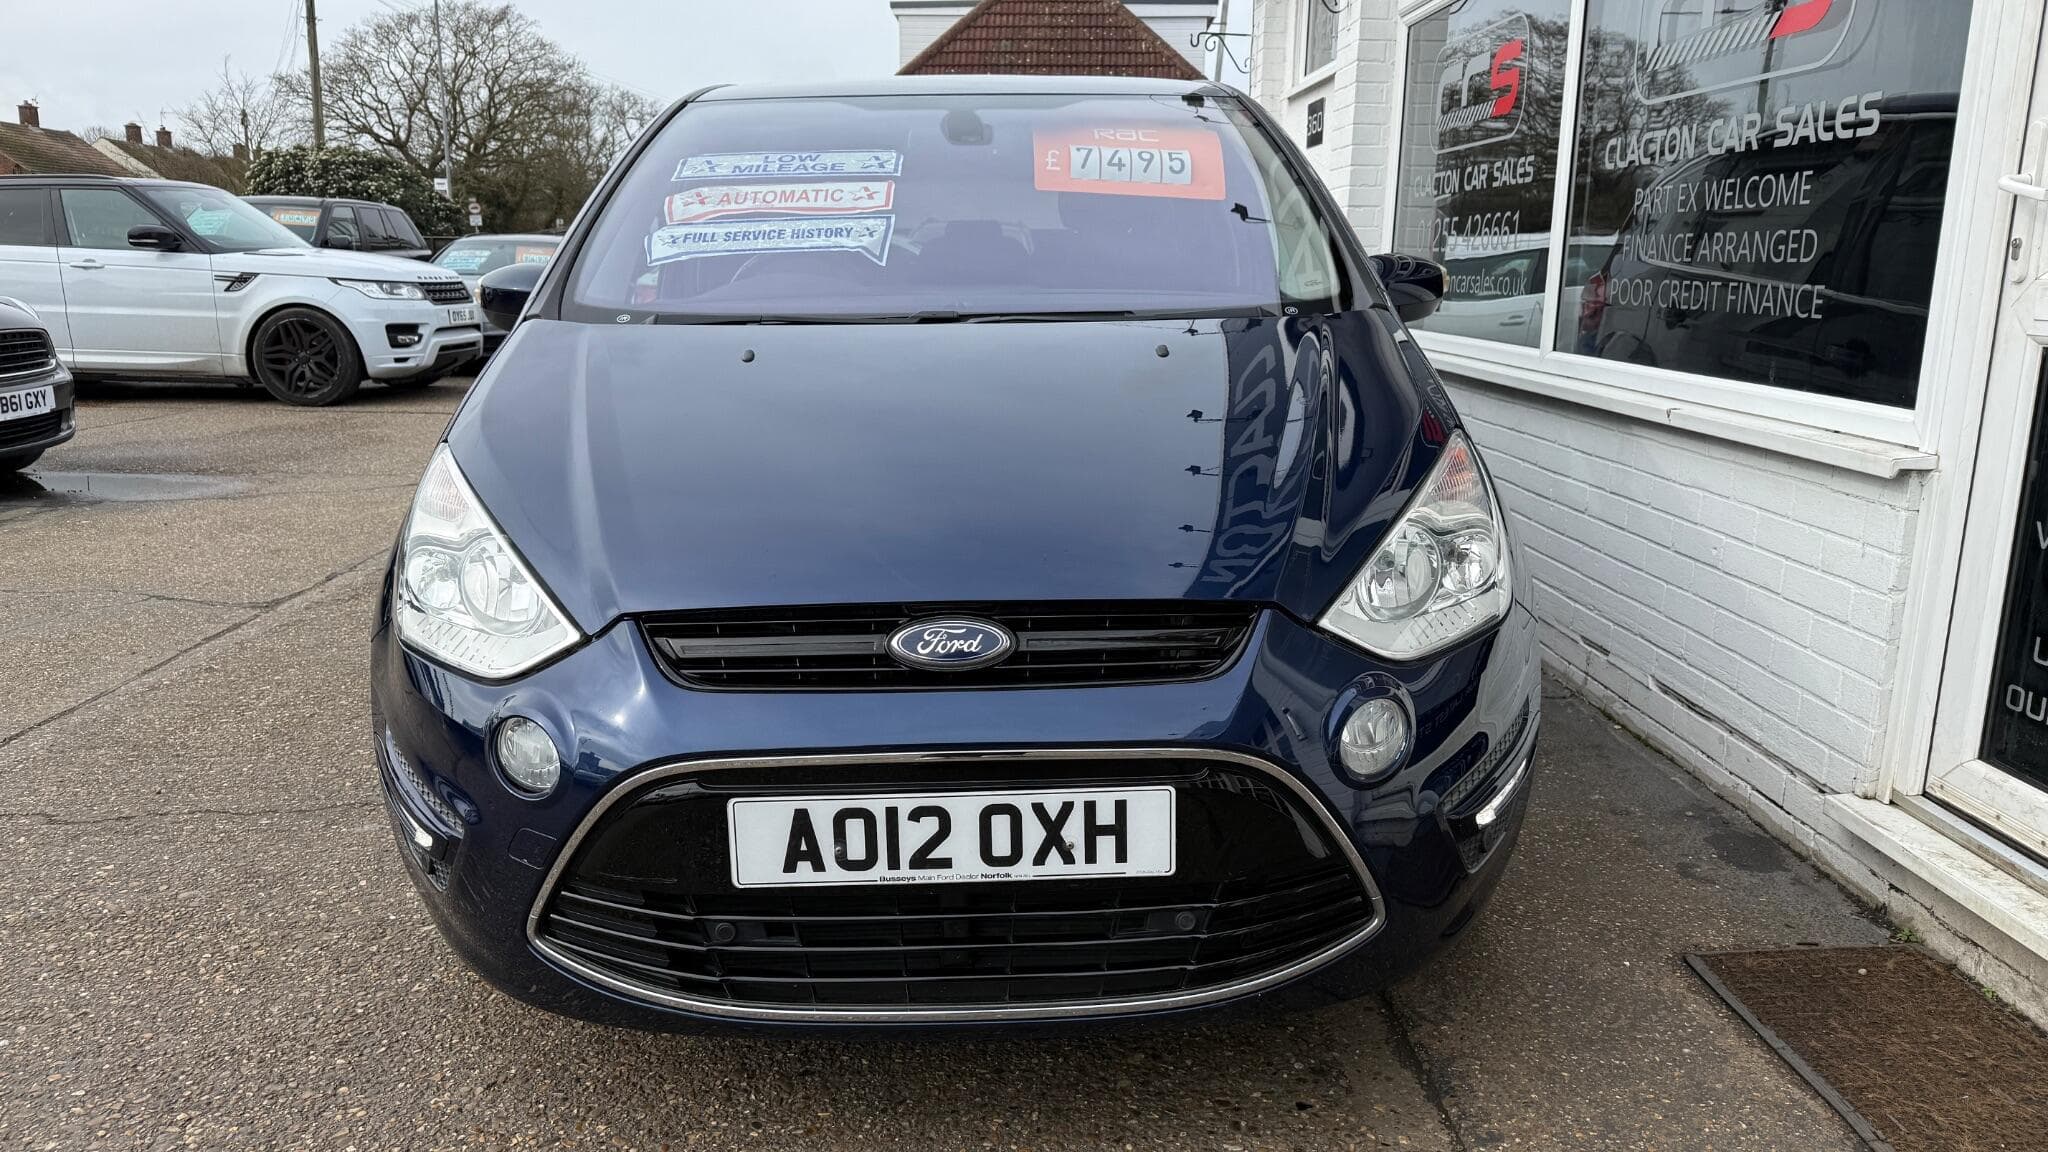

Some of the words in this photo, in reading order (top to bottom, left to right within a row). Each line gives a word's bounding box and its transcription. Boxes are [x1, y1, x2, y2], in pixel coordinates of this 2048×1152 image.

[1605, 124, 1697, 169] CLACTON
[1707, 112, 1762, 156] CAR
[1774, 90, 1883, 148] SALES
[731, 162, 846, 174] MILEAGE
[763, 153, 822, 164] LOW
[1414, 168, 1460, 197] CLACTON
[1463, 163, 1488, 191] CAR
[1492, 154, 1535, 187] SALES
[716, 188, 845, 206] AUTOMATIC
[1634, 184, 1673, 215] PART
[1677, 182, 1699, 213] EX
[1704, 170, 1814, 211] WELCOME
[682, 231, 718, 244] FULL
[723, 228, 786, 242] SERVICE
[790, 227, 854, 240] HISTORY
[1417, 216, 1459, 253] 01255
[1461, 209, 1520, 251] 426661
[1623, 232, 1693, 262] FINANCE
[1697, 228, 1818, 264] ARRANGED
[1448, 267, 1528, 296] ncarsales.co.uk
[1609, 278, 1653, 306] POOR
[1658, 280, 1722, 312] CREDIT
[1726, 281, 1825, 319] FINANCE
[0, 393, 23, 414] B61
[25, 389, 47, 410] GXY
[917, 628, 984, 654] Ford
[2006, 683, 2048, 726] OU
[782, 805, 953, 874] AO12
[978, 799, 1129, 868] OXH
[936, 873, 954, 881] Ford
[980, 872, 1013, 880] Norfolk
